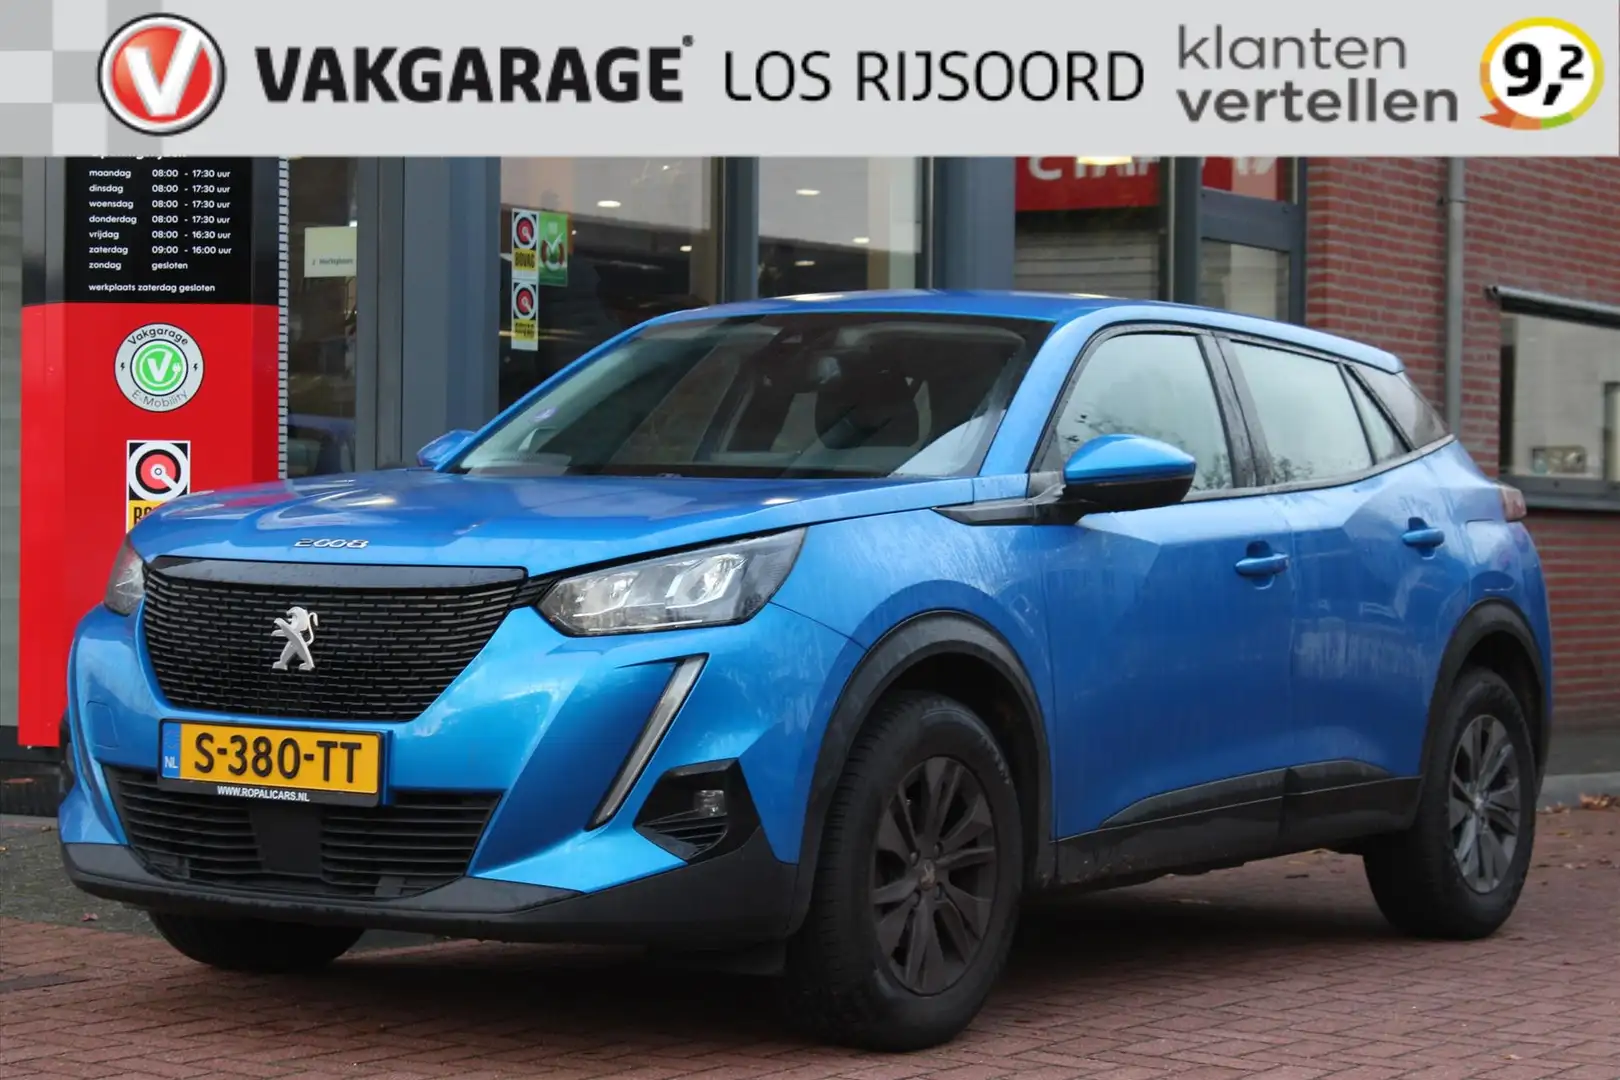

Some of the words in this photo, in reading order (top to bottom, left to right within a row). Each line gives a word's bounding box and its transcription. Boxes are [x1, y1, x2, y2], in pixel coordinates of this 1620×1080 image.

[88, 169, 131, 179] maandag
[151, 169, 179, 177] 08:00
[192, 169, 215, 177] 17:30
[88, 184, 123, 195] dinsdag
[151, 185, 179, 193] 08:00
[192, 185, 215, 193] 17:30
[88, 199, 134, 210] woensdag
[151, 200, 179, 208] 08:00
[192, 200, 215, 208] 17:30
[88, 214, 137, 225] donderdag
[151, 215, 179, 223] 08:00
[192, 215, 215, 223] 17:30
[88, 230, 120, 241] vrijdag
[151, 231, 179, 239] 08:00
[192, 231, 216, 239] 16:30
[88, 245, 129, 256] zaterdag
[151, 246, 179, 254] 09:00
[192, 246, 216, 254] 16:00
[88, 261, 122, 271] zondag
[151, 261, 189, 271] gesloten
[88, 283, 136, 293] werkplaats
[138, 283, 177, 293] zaterdag
[179, 284, 216, 294] gesloten
[127, 328, 189, 346] Vakgarage
[131, 389, 188, 408] E-Mobility
[294, 538, 369, 549] 2008
[164, 755, 179, 769] NL
[194, 732, 362, 783] S-380-TT
[217, 785, 310, 802] WWW.ROPALICARS.NL
